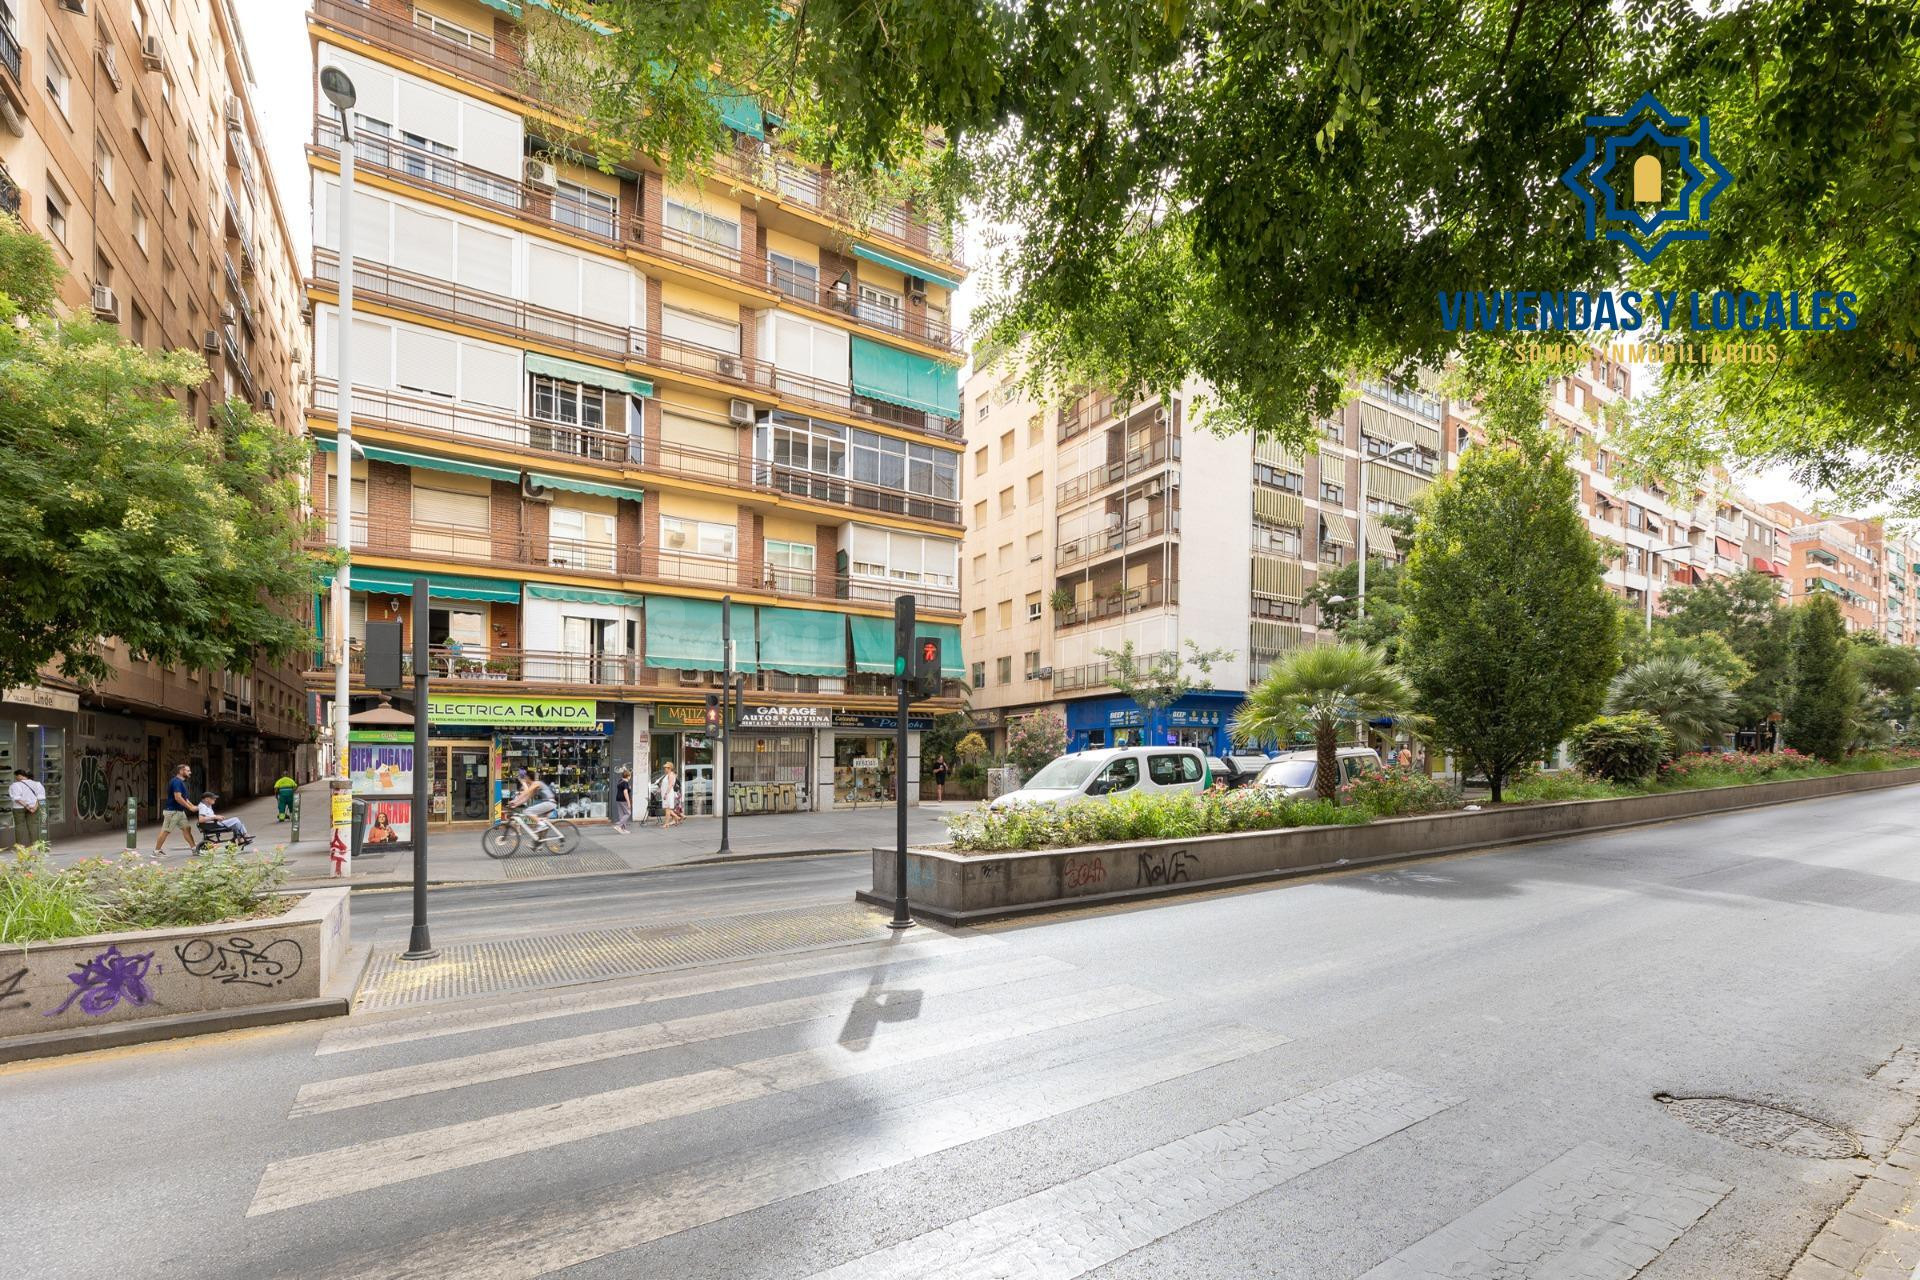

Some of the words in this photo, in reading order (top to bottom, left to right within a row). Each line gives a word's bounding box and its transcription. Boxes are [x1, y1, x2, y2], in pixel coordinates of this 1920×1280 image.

[428, 703, 516, 716] ELECTRICA
[520, 704, 590, 718] RONDA
[757, 706, 817, 715] GARAGE
[351, 747, 373, 772] BIEN
[375, 747, 413, 772] JUGADO
